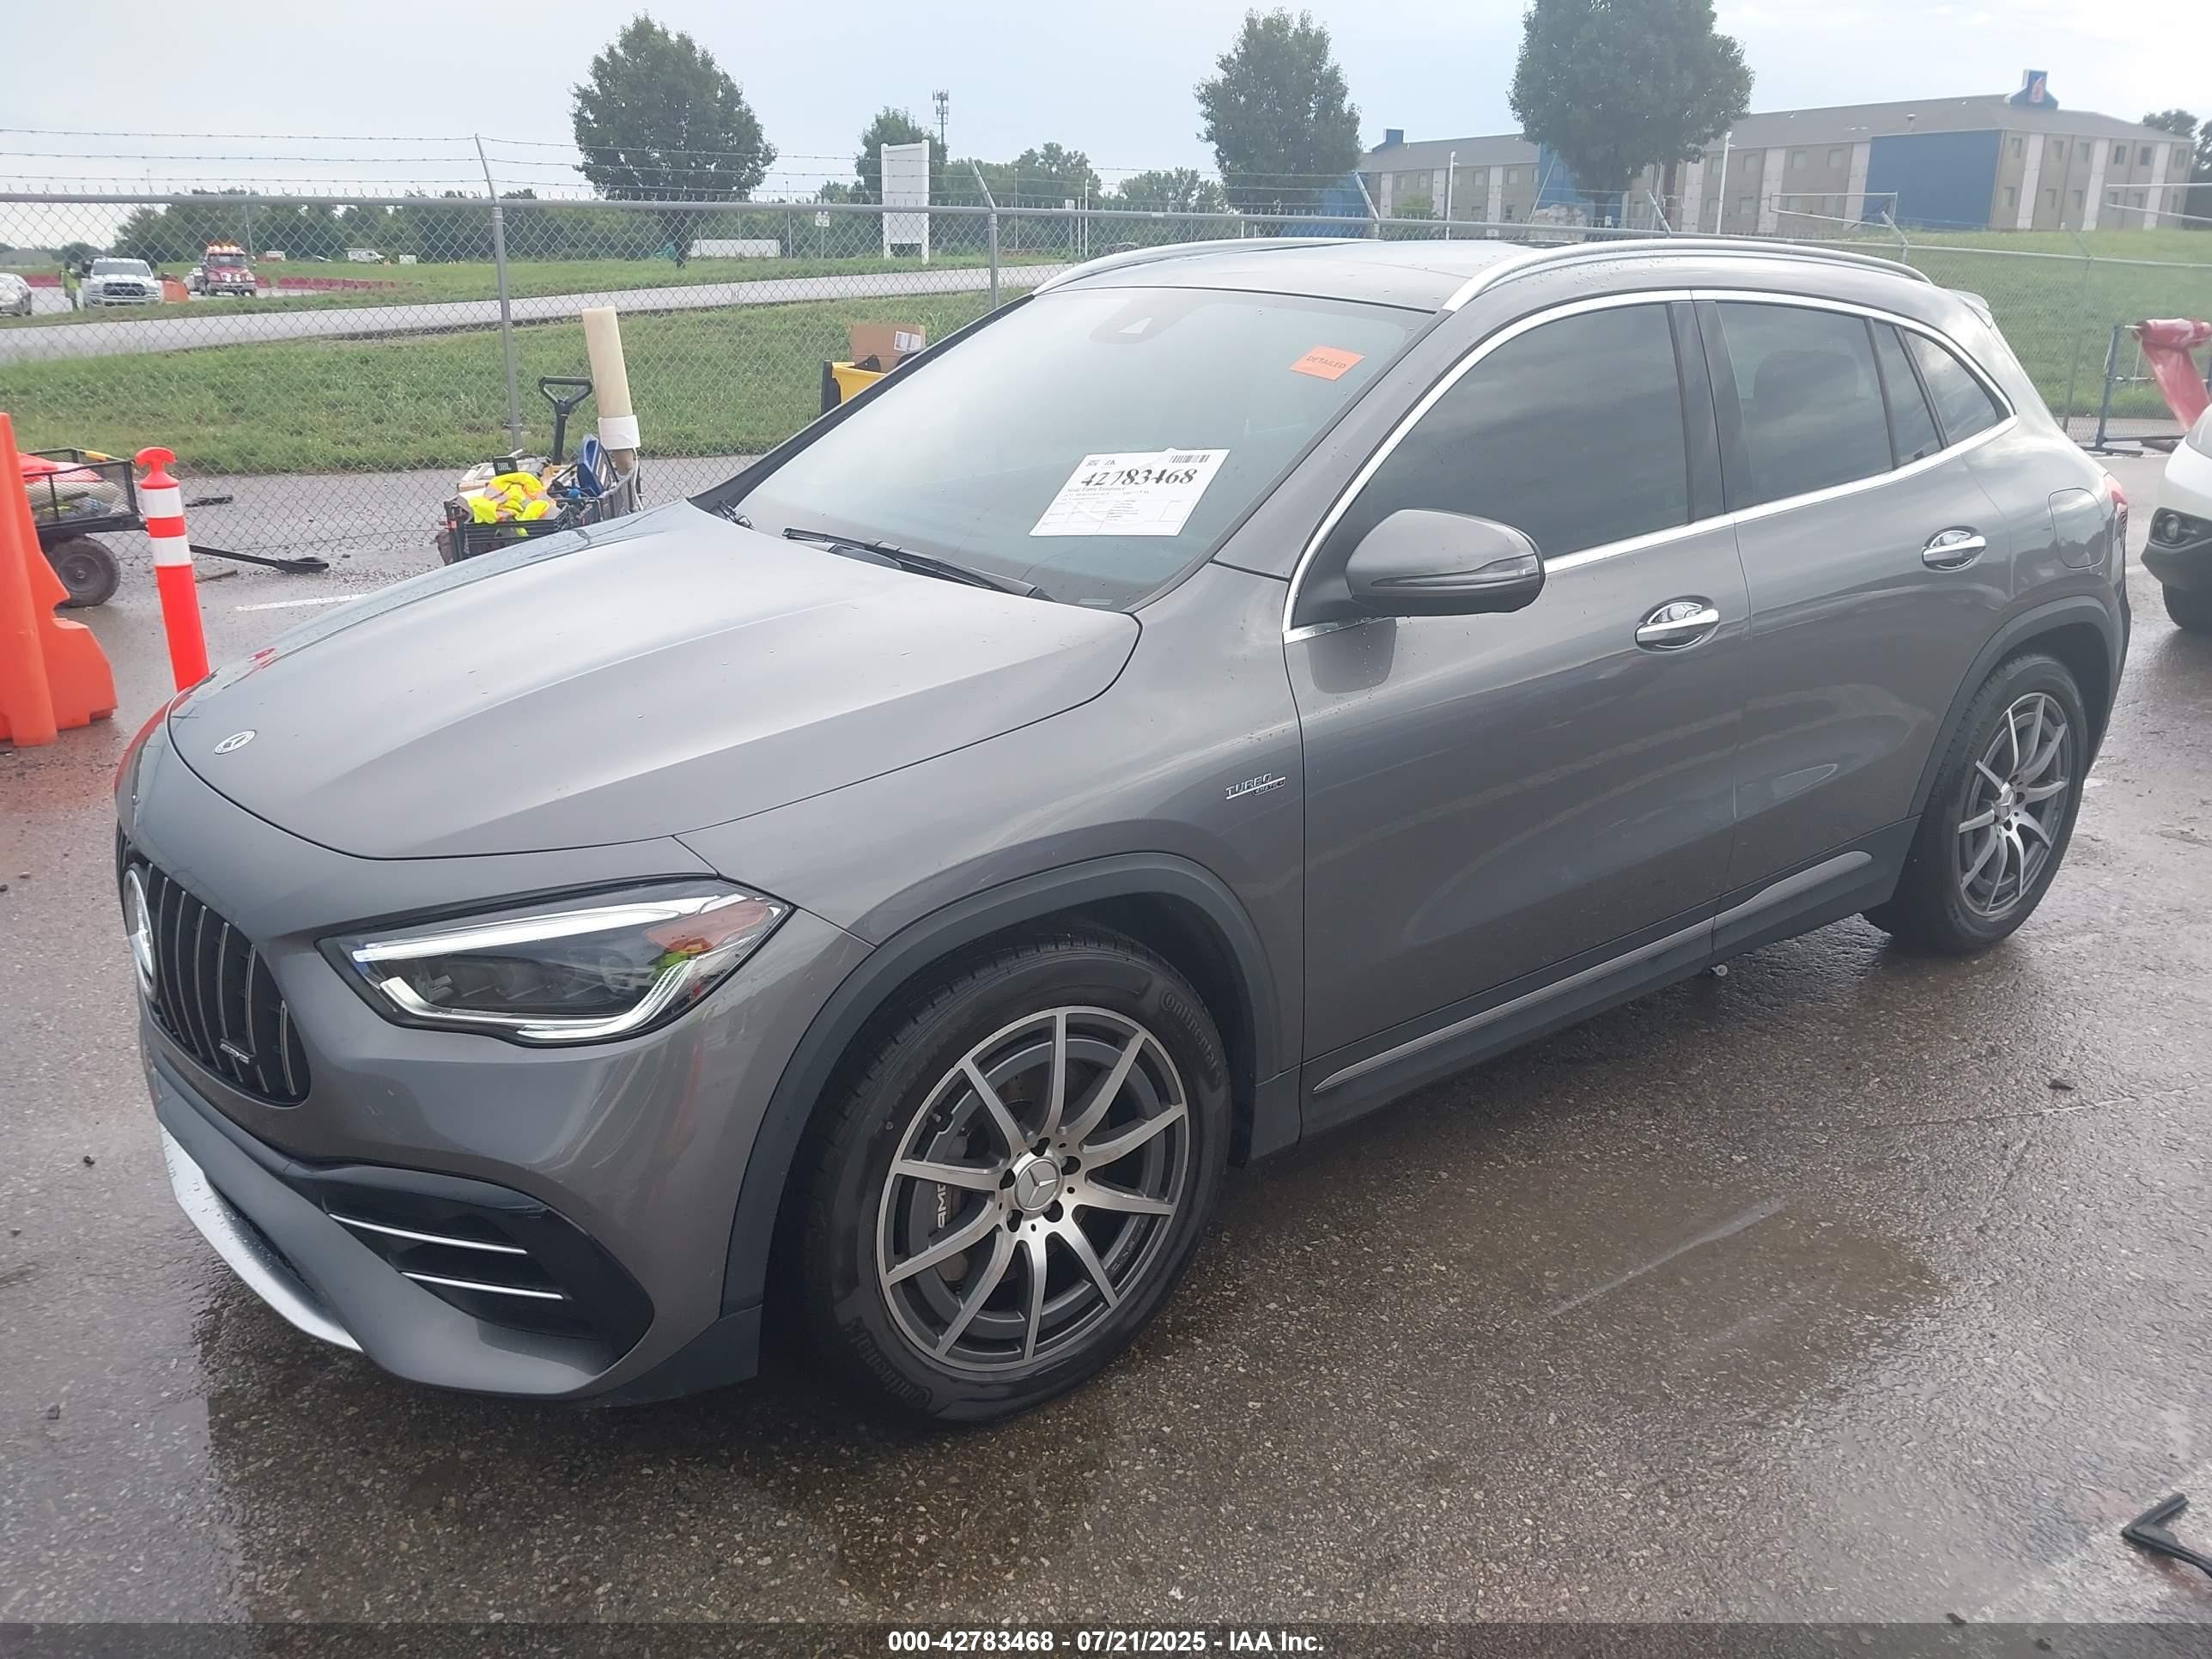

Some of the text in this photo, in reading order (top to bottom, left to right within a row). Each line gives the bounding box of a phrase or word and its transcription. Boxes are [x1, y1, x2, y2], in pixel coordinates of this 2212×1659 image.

[1305, 356, 1346, 369] DETAILED
[497, 462, 512, 471] JBL
[1159, 991, 1218, 1070] Continental
